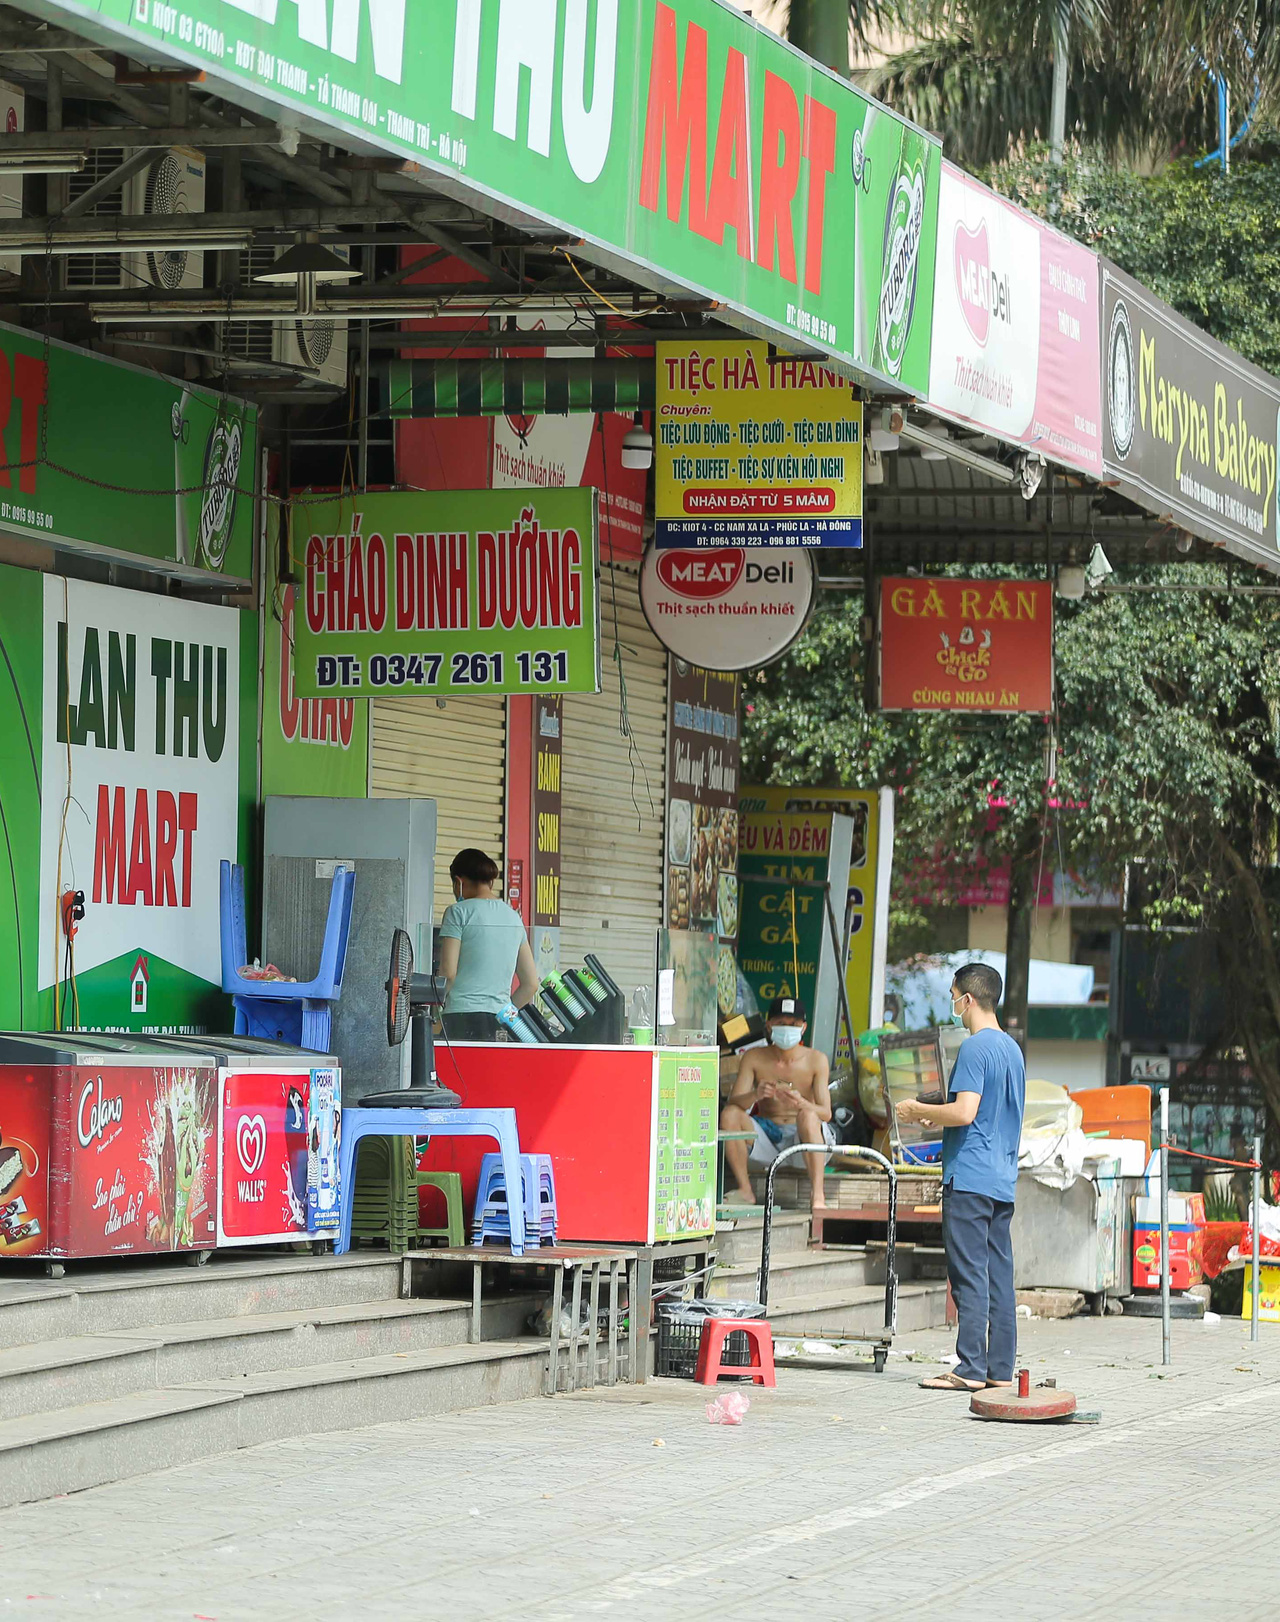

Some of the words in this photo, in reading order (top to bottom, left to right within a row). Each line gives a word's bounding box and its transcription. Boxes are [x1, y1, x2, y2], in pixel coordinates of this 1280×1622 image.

[152, 1, 177, 35] KIOT
[179, 14, 192, 41] 03
[194, 20, 224, 58] CT10A
[235, 39, 254, 69] KĐT
[258, 48, 274, 88] ĐẠI
[277, 57, 307, 95] THANH
[317, 72, 329, 103] TẢ
[331, 84, 360, 119] THANH
[362, 98, 378, 127] OAI
[387, 109, 414, 139] THANH
[417, 120, 430, 149] TRÌ
[439, 132, 450, 160] HÀ
[453, 138, 467, 170] NỘI
[639, 1, 837, 296] MART
[880, 217, 916, 332] TUBORG
[960, 254, 989, 311] MEAT
[991, 271, 1011, 324] Deli
[665, 350, 715, 396] TIỆC
[723, 349, 759, 390] HÀ
[660, 404, 712, 417] Chuyên:
[660, 418, 681, 448] TIỆC
[683, 421, 702, 445] LƯU
[703, 418, 730, 447] ĐỘNG
[739, 418, 761, 448] TIỆC
[762, 418, 784, 444] CƯỚI
[793, 418, 815, 448] TIỆC
[817, 422, 833, 443] GIA
[835, 418, 859, 443] ĐÌNH
[1139, 328, 1210, 480] Maryna
[1214, 381, 1275, 528] Bakery
[672, 455, 694, 484] TIỆC
[696, 458, 729, 480] BUFFET
[738, 454, 760, 484] TIỆC
[761, 456, 776, 483] SỰ
[776, 454, 799, 483] KIỆN
[802, 454, 818, 483] HỘI
[820, 457, 844, 483] NGHỊ
[689, 494, 727, 509] NHẬN
[730, 493, 757, 510] ĐẶT
[760, 492, 778, 506] TỪ
[783, 496, 793, 507] 5
[796, 492, 830, 507] MÂM
[667, 522, 681, 532] ĐC:
[682, 522, 699, 532] KIOT
[701, 522, 707, 532] 4
[714, 522, 725, 532] CC
[727, 522, 745, 532] NAM
[747, 522, 758, 532] XA
[760, 522, 769, 532] LA
[776, 519, 797, 532] PHÚC
[800, 521, 809, 531] LA
[817, 519, 827, 531] HÀ
[829, 519, 851, 531] ĐÔNG
[697, 536, 708, 546] ĐT:
[710, 536, 729, 546] 0964
[731, 536, 745, 546] 339
[748, 536, 762, 546] 223
[769, 536, 784, 546] 096
[786, 536, 800, 545] 881
[802, 535, 821, 545] 5556
[305, 513, 387, 635] CHÁO
[393, 531, 470, 632] DINH
[476, 502, 583, 630] DƯỠNG
[671, 562, 735, 583] MEAT
[745, 561, 793, 584] Deli
[657, 602, 683, 616] Thịt
[685, 602, 715, 617] sạch
[761, 600, 795, 615] khiết
[891, 580, 947, 618] GÀ
[960, 582, 1037, 620] RÁN
[317, 654, 361, 687] ĐT:
[369, 652, 444, 687] 0347
[450, 651, 504, 685] 261
[515, 650, 568, 684] 131
[936, 646, 991, 667] Chick
[958, 665, 987, 682] Go
[57, 621, 136, 752] LAN
[151, 637, 227, 763] THU
[913, 686, 951, 704] CÙNG
[955, 690, 995, 705] NHAU
[999, 688, 1019, 706] ĂN
[537, 744, 560, 793] BÁNH
[92, 784, 197, 908] MART
[537, 813, 559, 853] SINH
[763, 819, 784, 850] VÀ
[789, 819, 827, 851] ĐÊM
[763, 864, 814, 882] TIM
[536, 868, 560, 923] NHẬT
[759, 894, 813, 918] CẬT
[760, 924, 799, 944] GÀ
[759, 982, 792, 999] GÀ
[78, 1075, 123, 1149] Celano
[92, 1177, 108, 1209] Sao
[108, 1168, 126, 1211] phải
[237, 1179, 265, 1203] WALL'S
